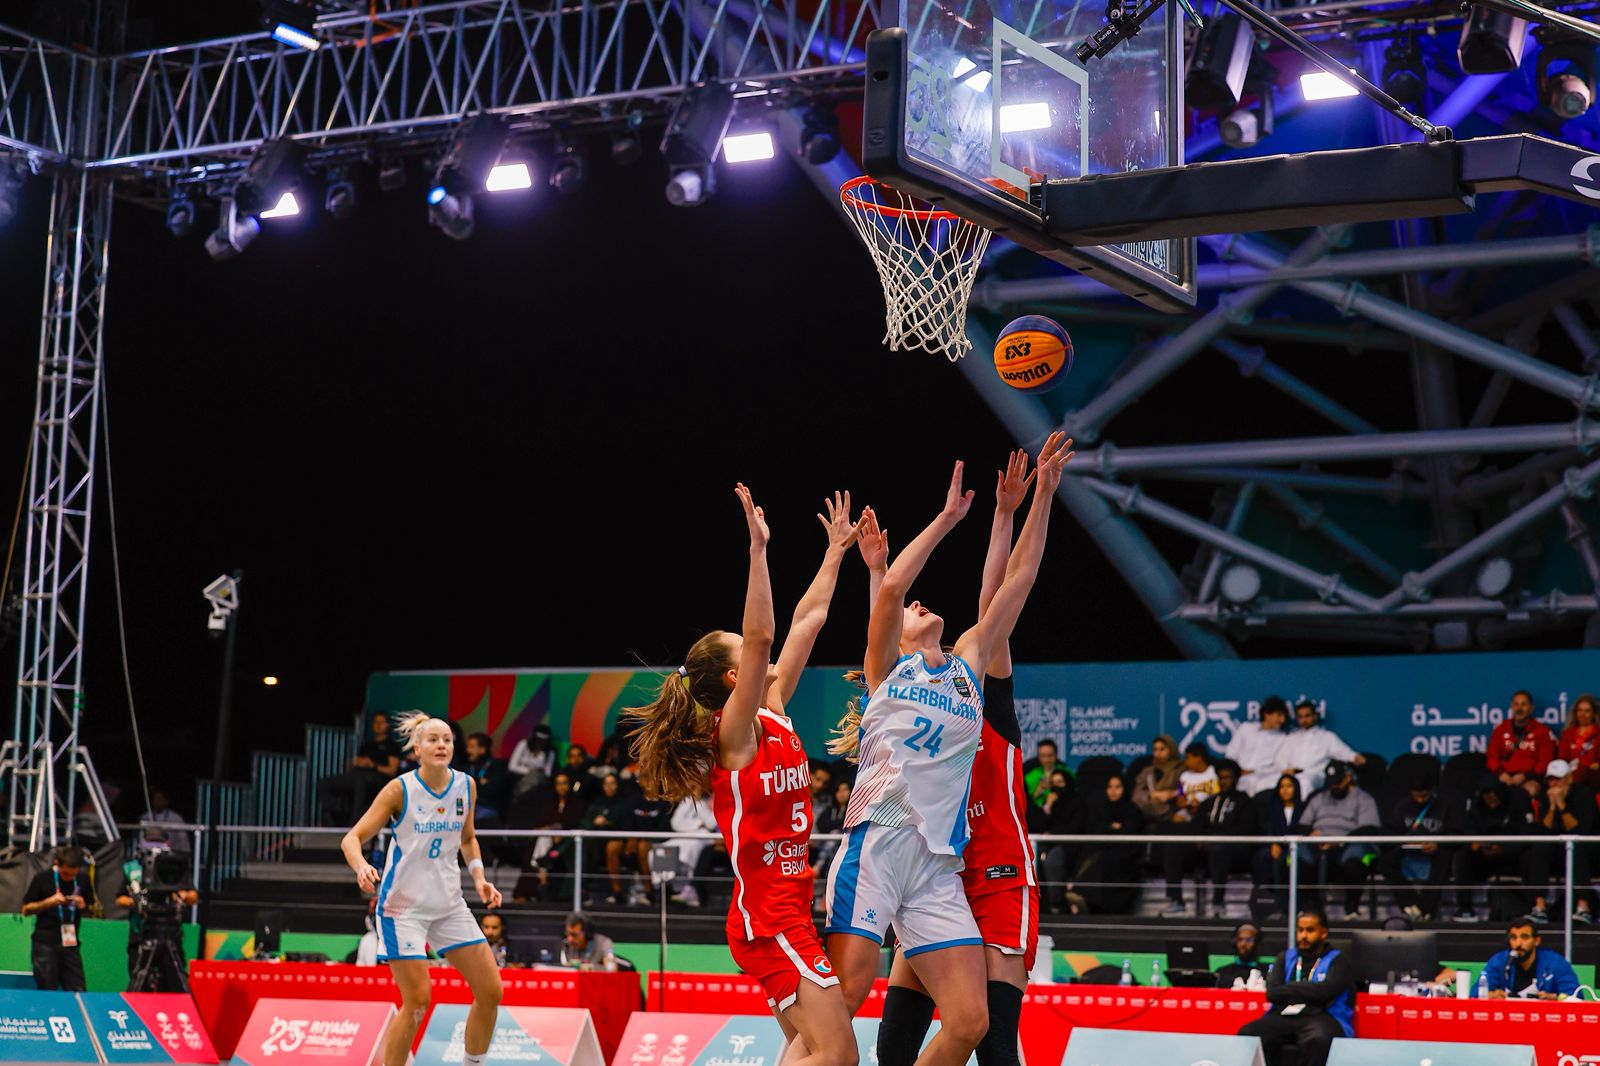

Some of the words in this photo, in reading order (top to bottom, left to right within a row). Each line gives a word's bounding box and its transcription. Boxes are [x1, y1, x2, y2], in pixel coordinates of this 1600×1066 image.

[1001, 362, 1052, 382] Wilson
[887, 684, 977, 721] AZERBAIJAN
[1070, 706, 1115, 718] ISLAMIC
[1070, 718, 1139, 731] SOLIDARITY
[904, 716, 945, 758] 24
[1070, 731, 1114, 743] SPORTS
[1410, 735, 1463, 756] ONE
[1070, 743, 1147, 756] ASSOCIATION
[791, 801, 808, 832] 5
[428, 838, 442, 859] 8
